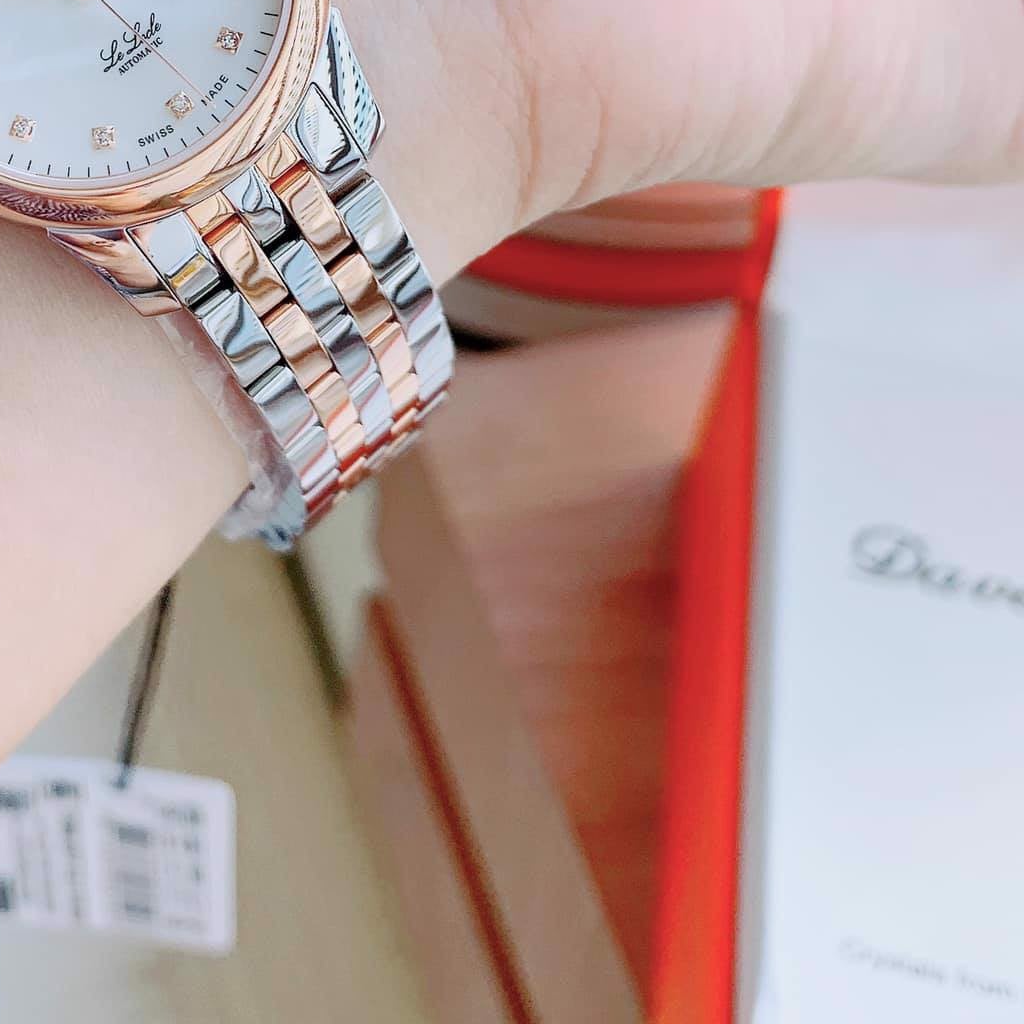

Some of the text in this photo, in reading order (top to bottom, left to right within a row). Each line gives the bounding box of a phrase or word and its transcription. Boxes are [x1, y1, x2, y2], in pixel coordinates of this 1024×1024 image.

[99, 39, 125, 73] Le
[118, 36, 164, 76] AUTOMAIC
[137, 124, 175, 148] SWISS
